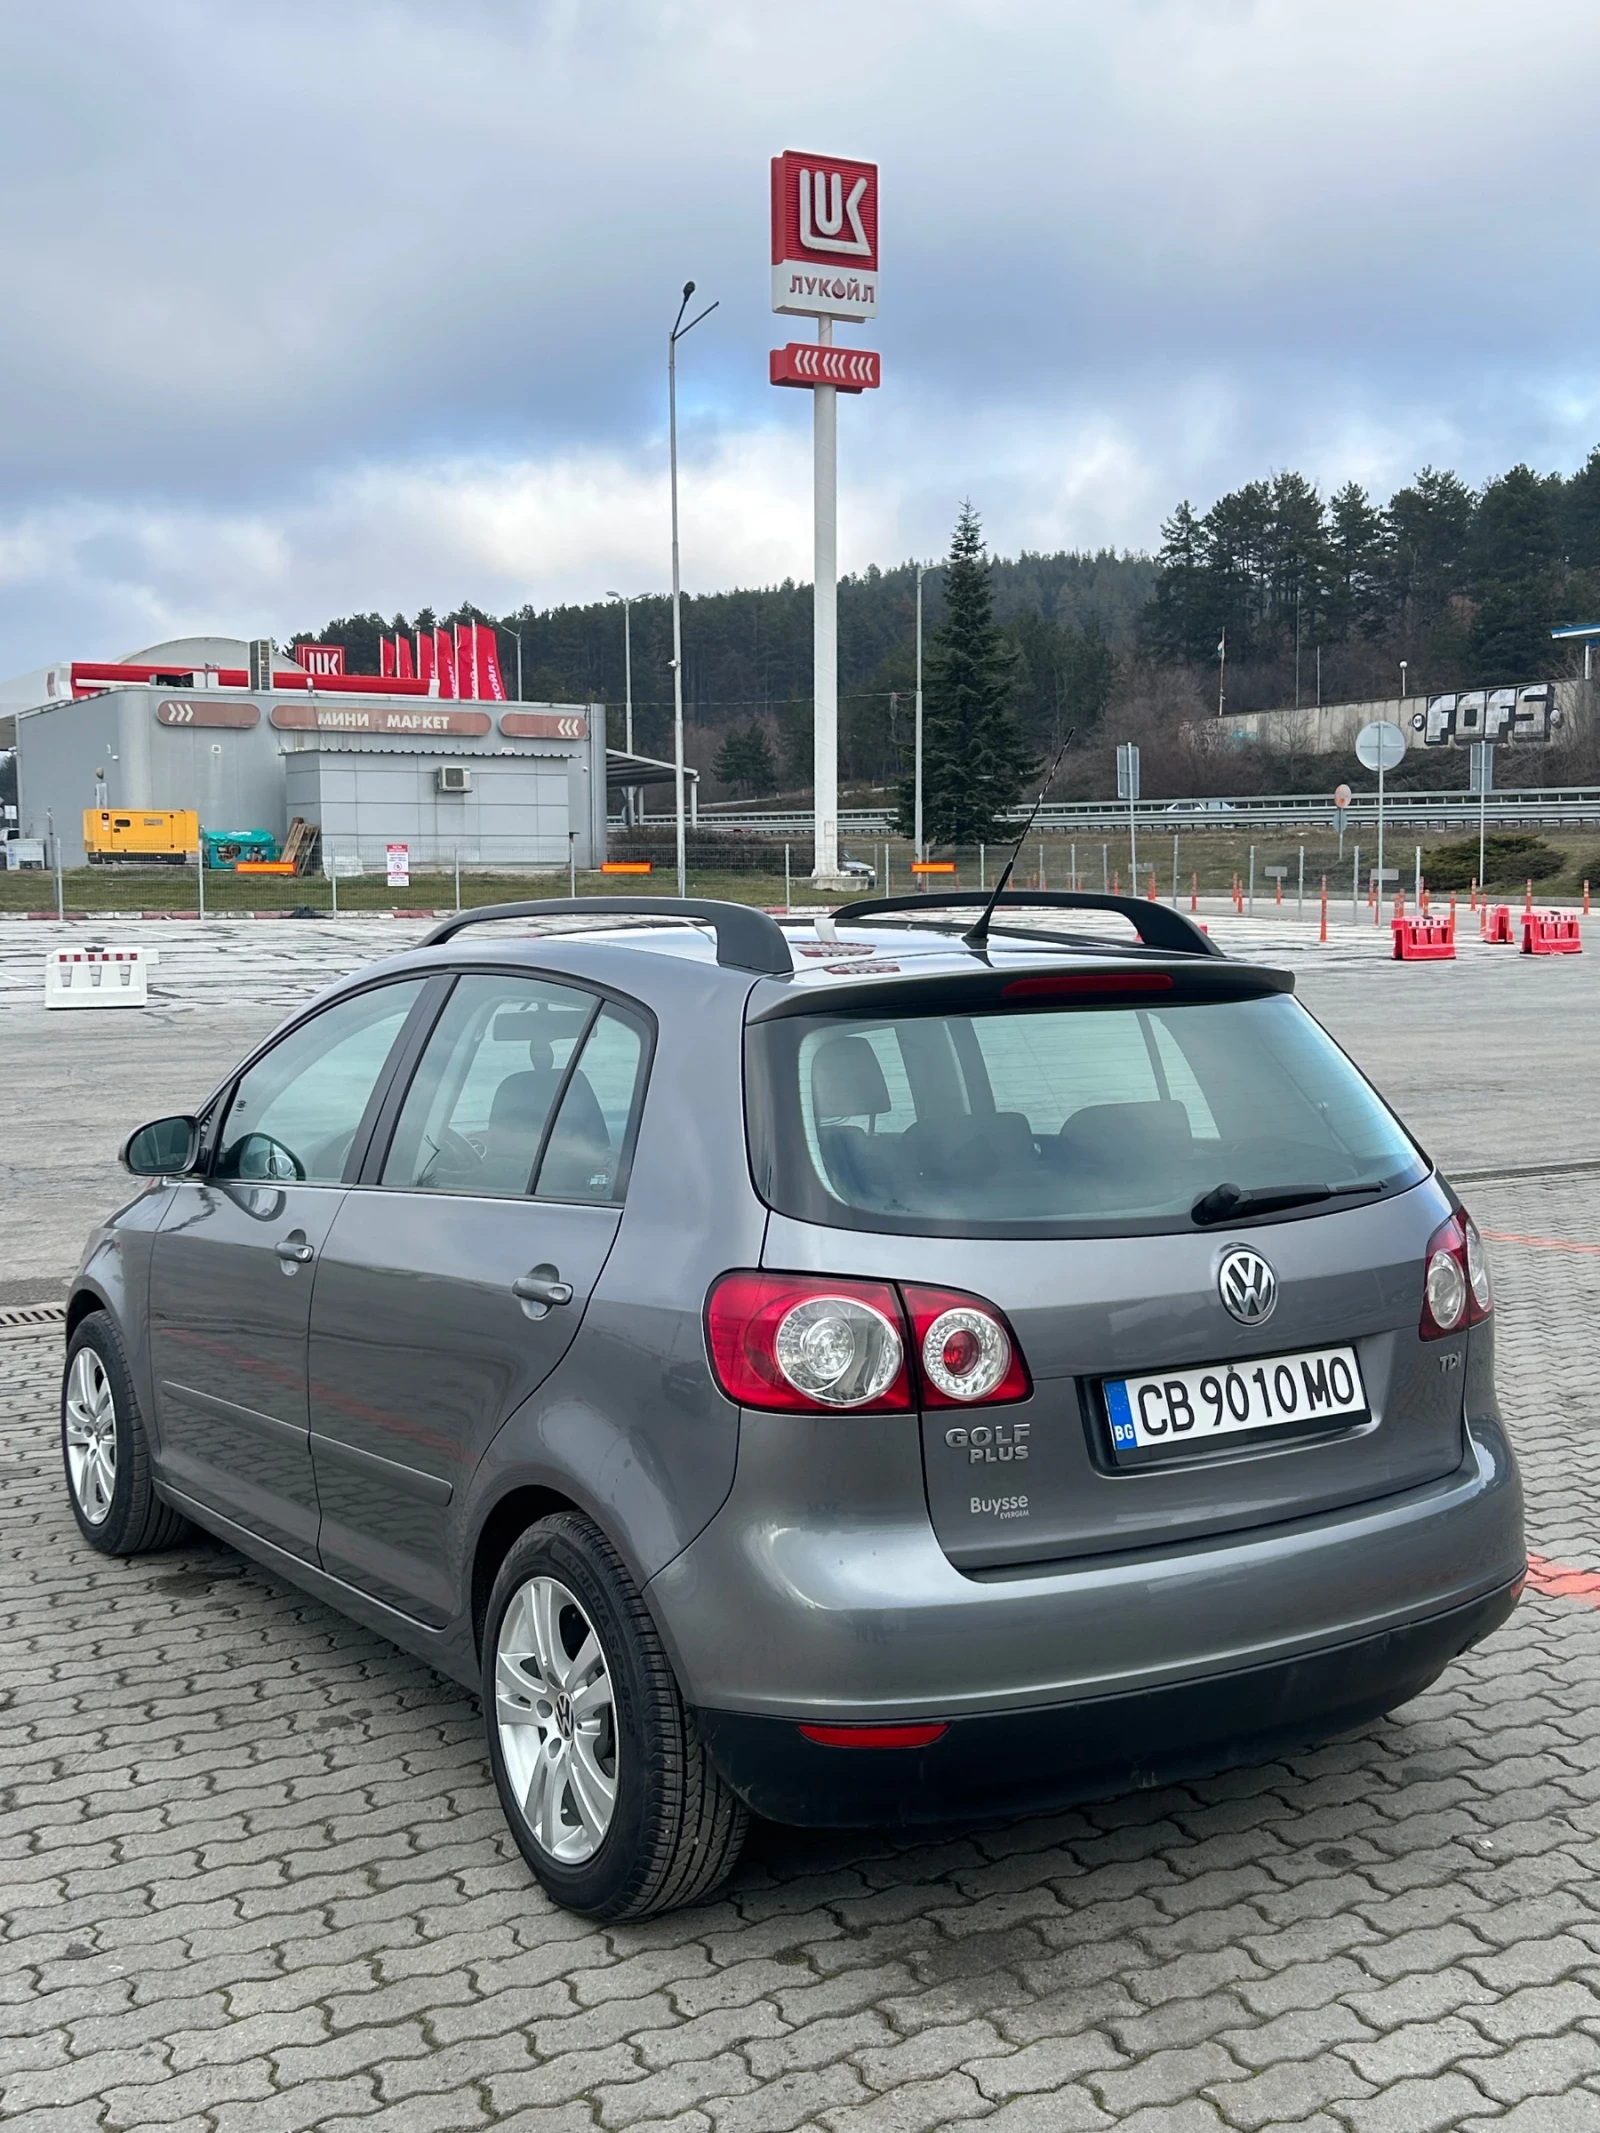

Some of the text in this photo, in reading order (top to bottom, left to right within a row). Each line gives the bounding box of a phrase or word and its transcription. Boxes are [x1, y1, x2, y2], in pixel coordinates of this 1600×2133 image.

[317, 712, 369, 727] МИНИ
[386, 715, 450, 730] МАРКЕТ
[1440, 1351, 1461, 1372] TDI
[1137, 1356, 1355, 1436] CB 9010 MO
[945, 1423, 1031, 1448] GOLF
[1113, 1423, 1134, 1442] BG
[969, 1445, 1029, 1464] PLUS
[970, 1495, 1029, 1516] Buysse
[562, 1554, 610, 1628] ATHENA
